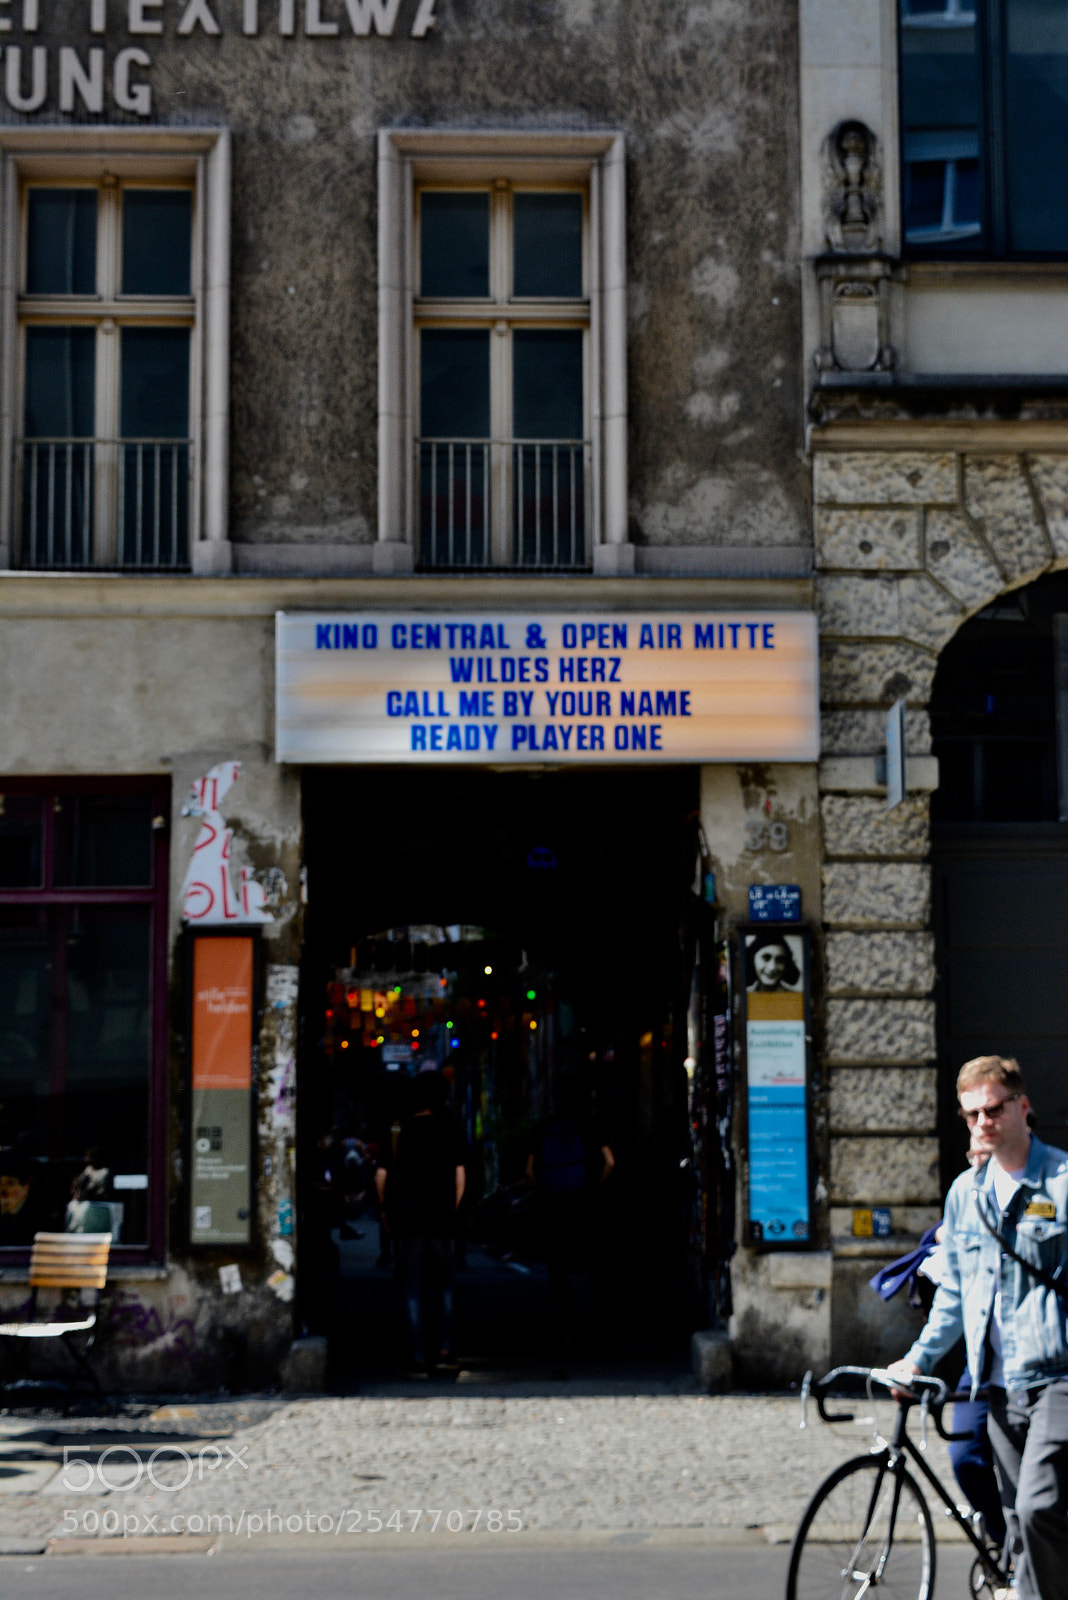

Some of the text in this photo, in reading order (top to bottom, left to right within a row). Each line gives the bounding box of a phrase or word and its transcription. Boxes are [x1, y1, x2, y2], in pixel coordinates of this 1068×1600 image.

[0, 46, 152, 116] UNG
[316, 623, 775, 649] KINO CENTRAL & OPEN AIR MITTE
[449, 657, 622, 683] WILDES HERZ
[386, 691, 692, 717] CALL ME BY YOUR NAME
[411, 724, 663, 751] READY PLAYER ONE
